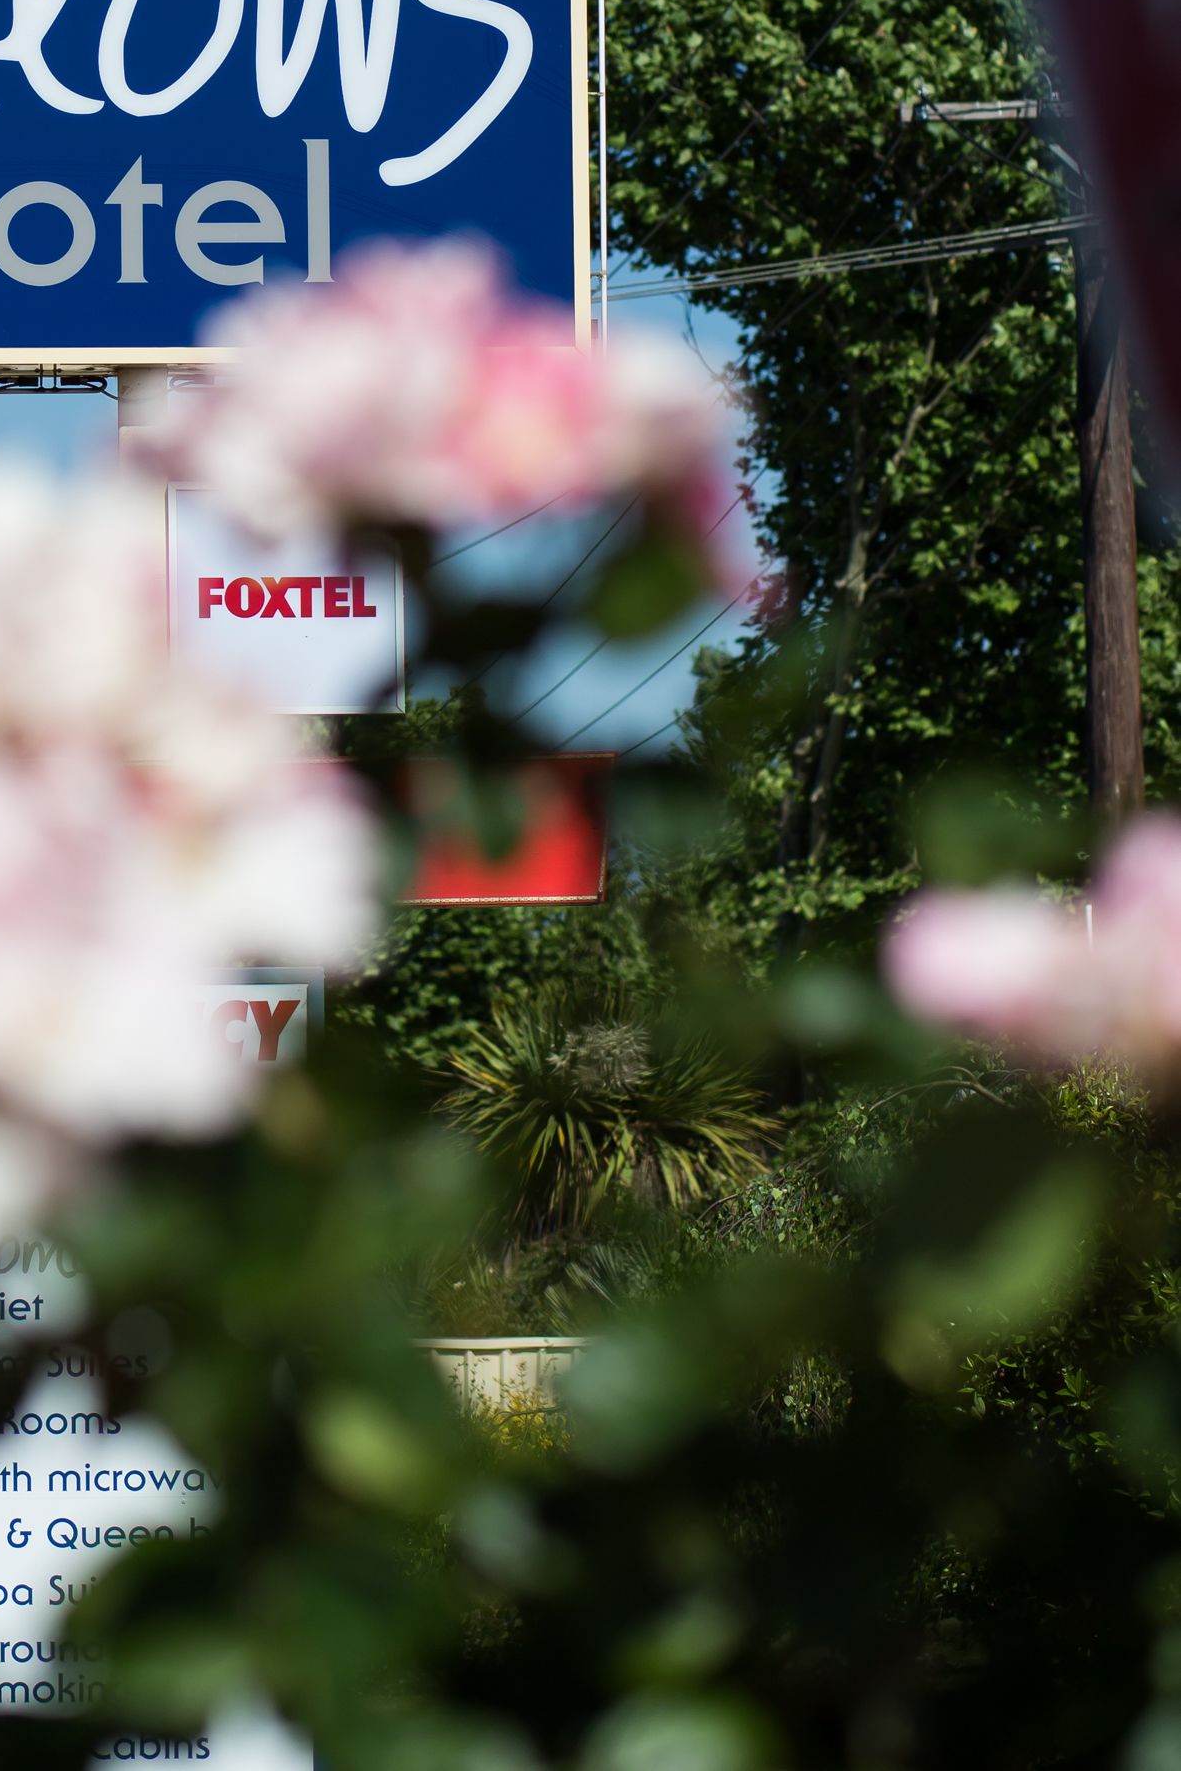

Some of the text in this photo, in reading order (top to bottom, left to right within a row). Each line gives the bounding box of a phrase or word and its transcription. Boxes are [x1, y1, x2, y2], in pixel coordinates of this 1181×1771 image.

[198, 576, 377, 619] FOXTEL
[48, 1462, 224, 1493] microwav
[7, 1519, 32, 1549] &
[47, 1517, 175, 1551] Queen
